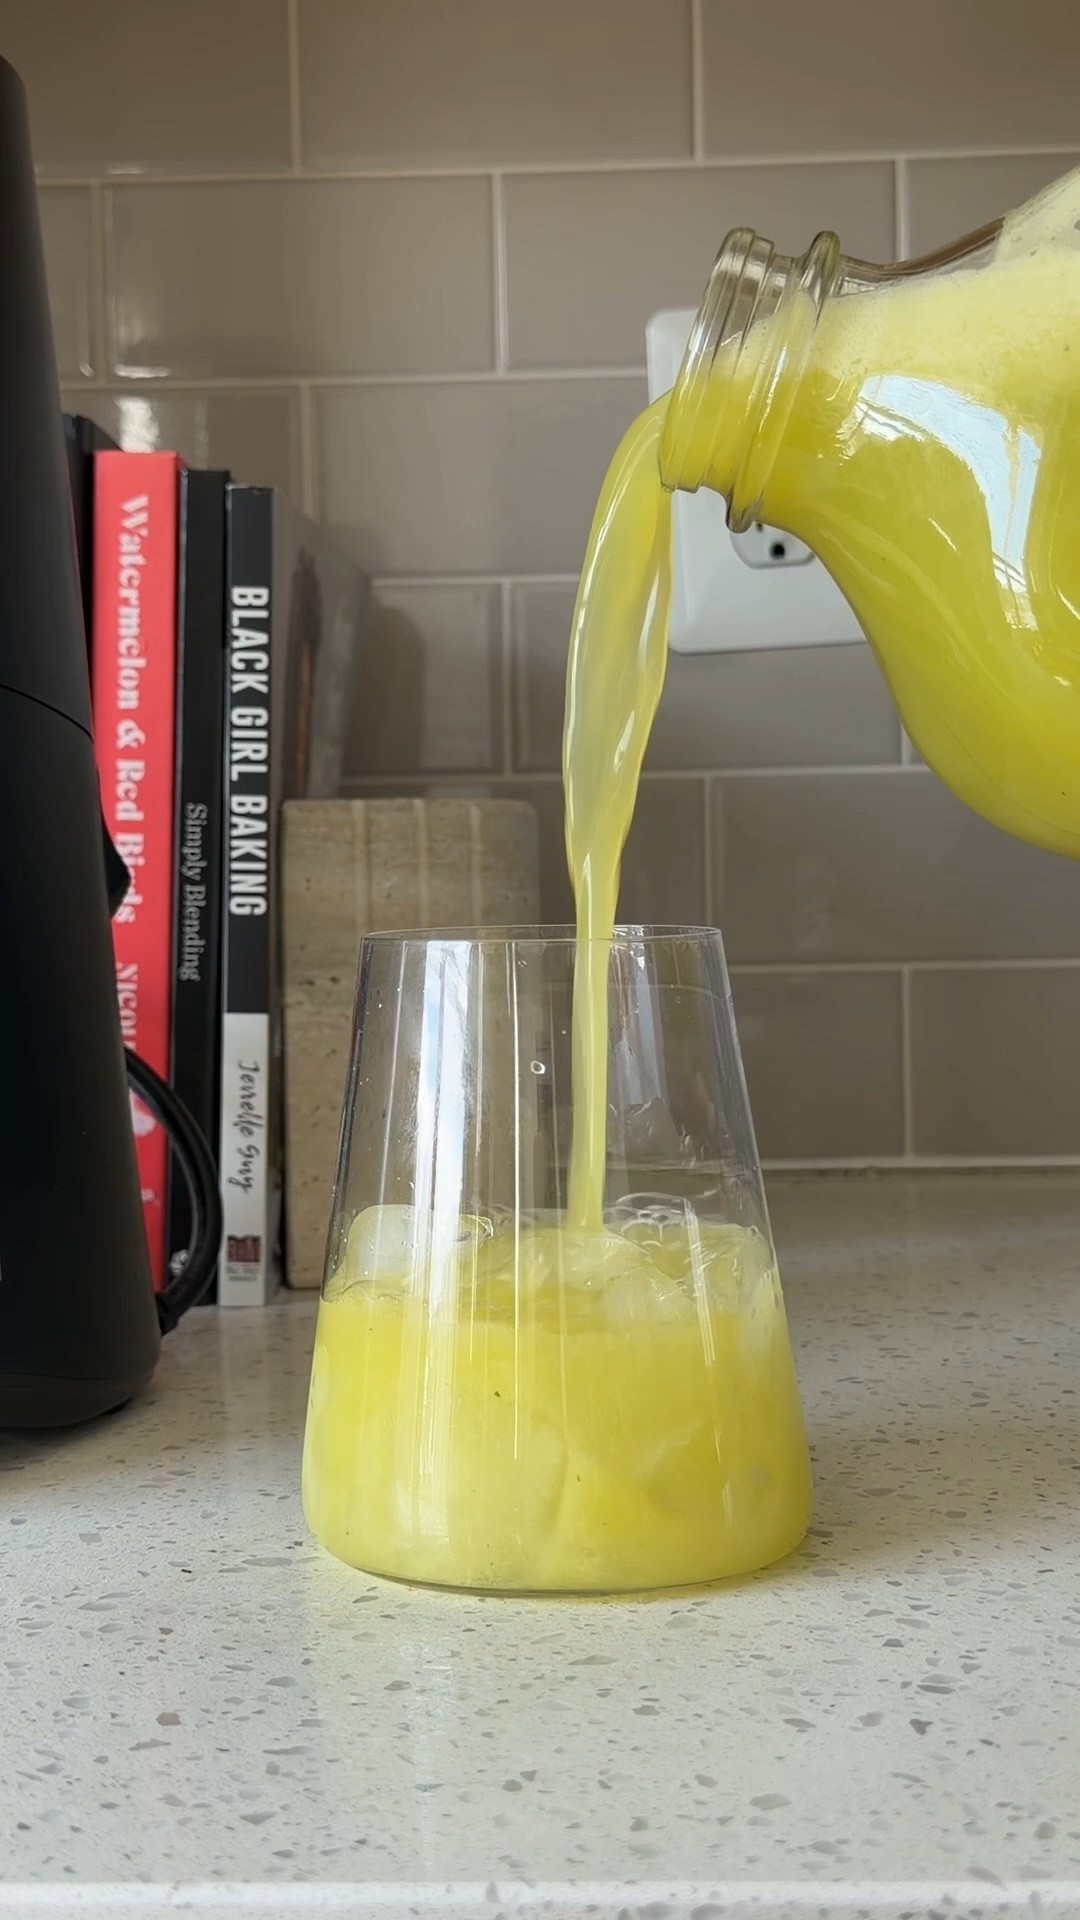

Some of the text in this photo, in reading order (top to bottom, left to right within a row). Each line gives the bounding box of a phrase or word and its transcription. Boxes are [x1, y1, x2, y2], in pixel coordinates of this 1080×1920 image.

[115, 493, 149, 923] Watermelon & Red Bids
[229, 586, 269, 915] BLACK GIRL BAKING
[178, 803, 207, 982] Simply Blending
